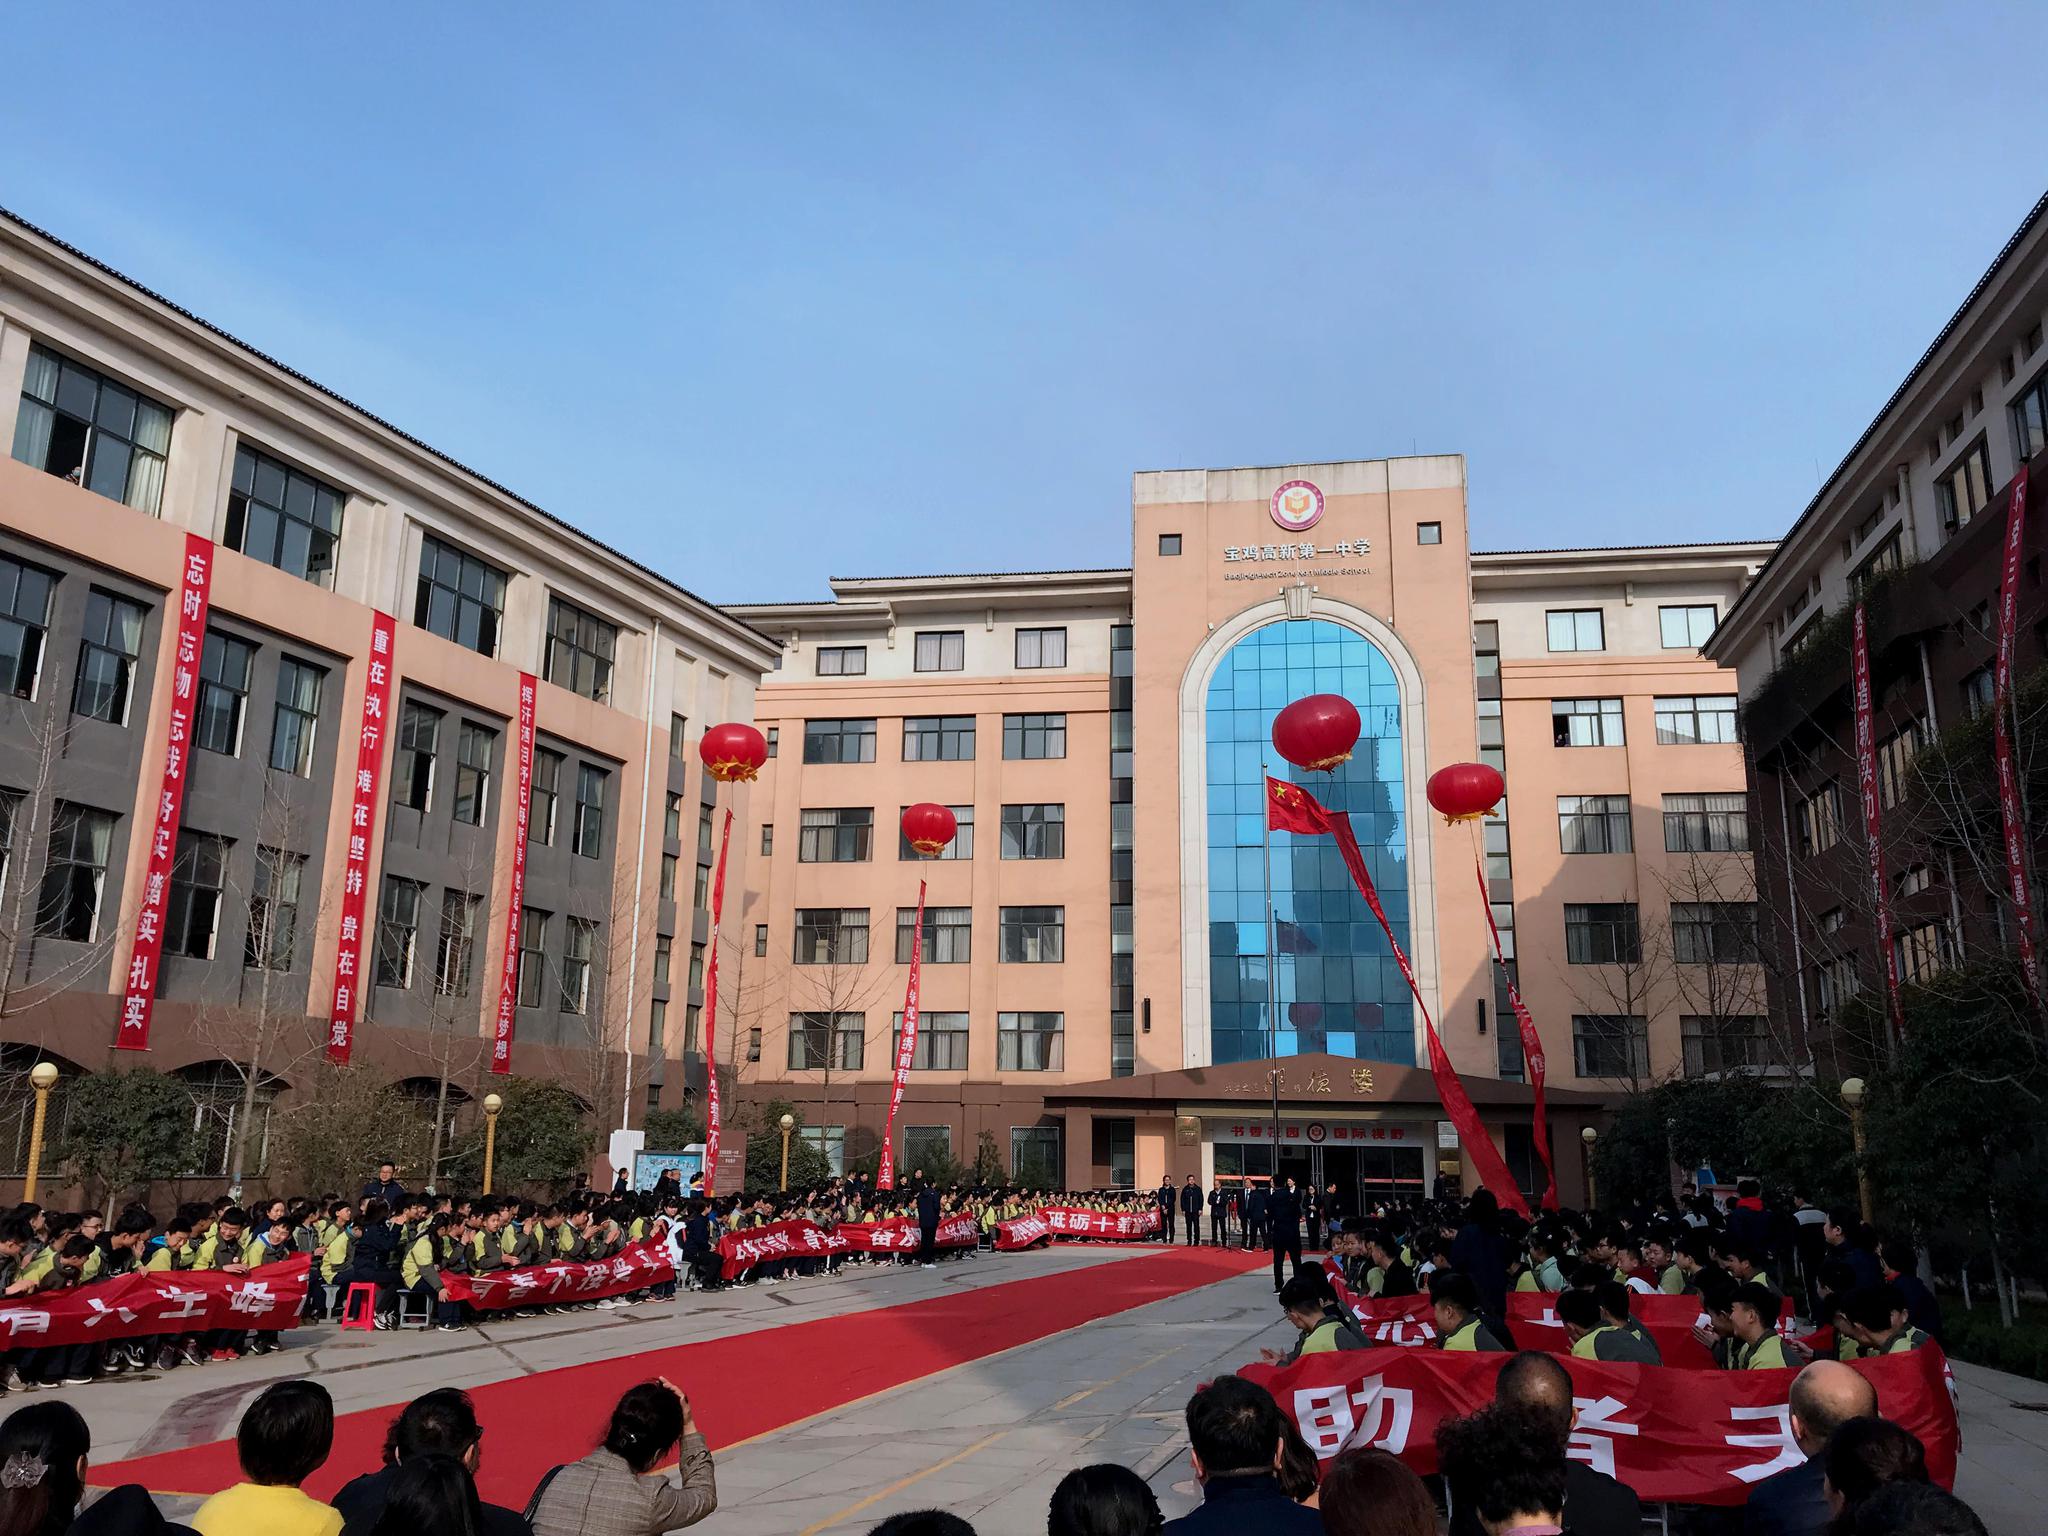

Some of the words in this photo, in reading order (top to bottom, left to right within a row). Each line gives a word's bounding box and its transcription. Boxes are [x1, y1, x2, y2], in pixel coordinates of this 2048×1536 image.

[1224, 538, 1371, 562] 宝鸡高新第一中学
[1341, 567, 1371, 575] School
[363, 628, 390, 749] 重在执行
[346, 769, 373, 896] 难在坚持
[332, 915, 358, 1048] 贵在自觉
